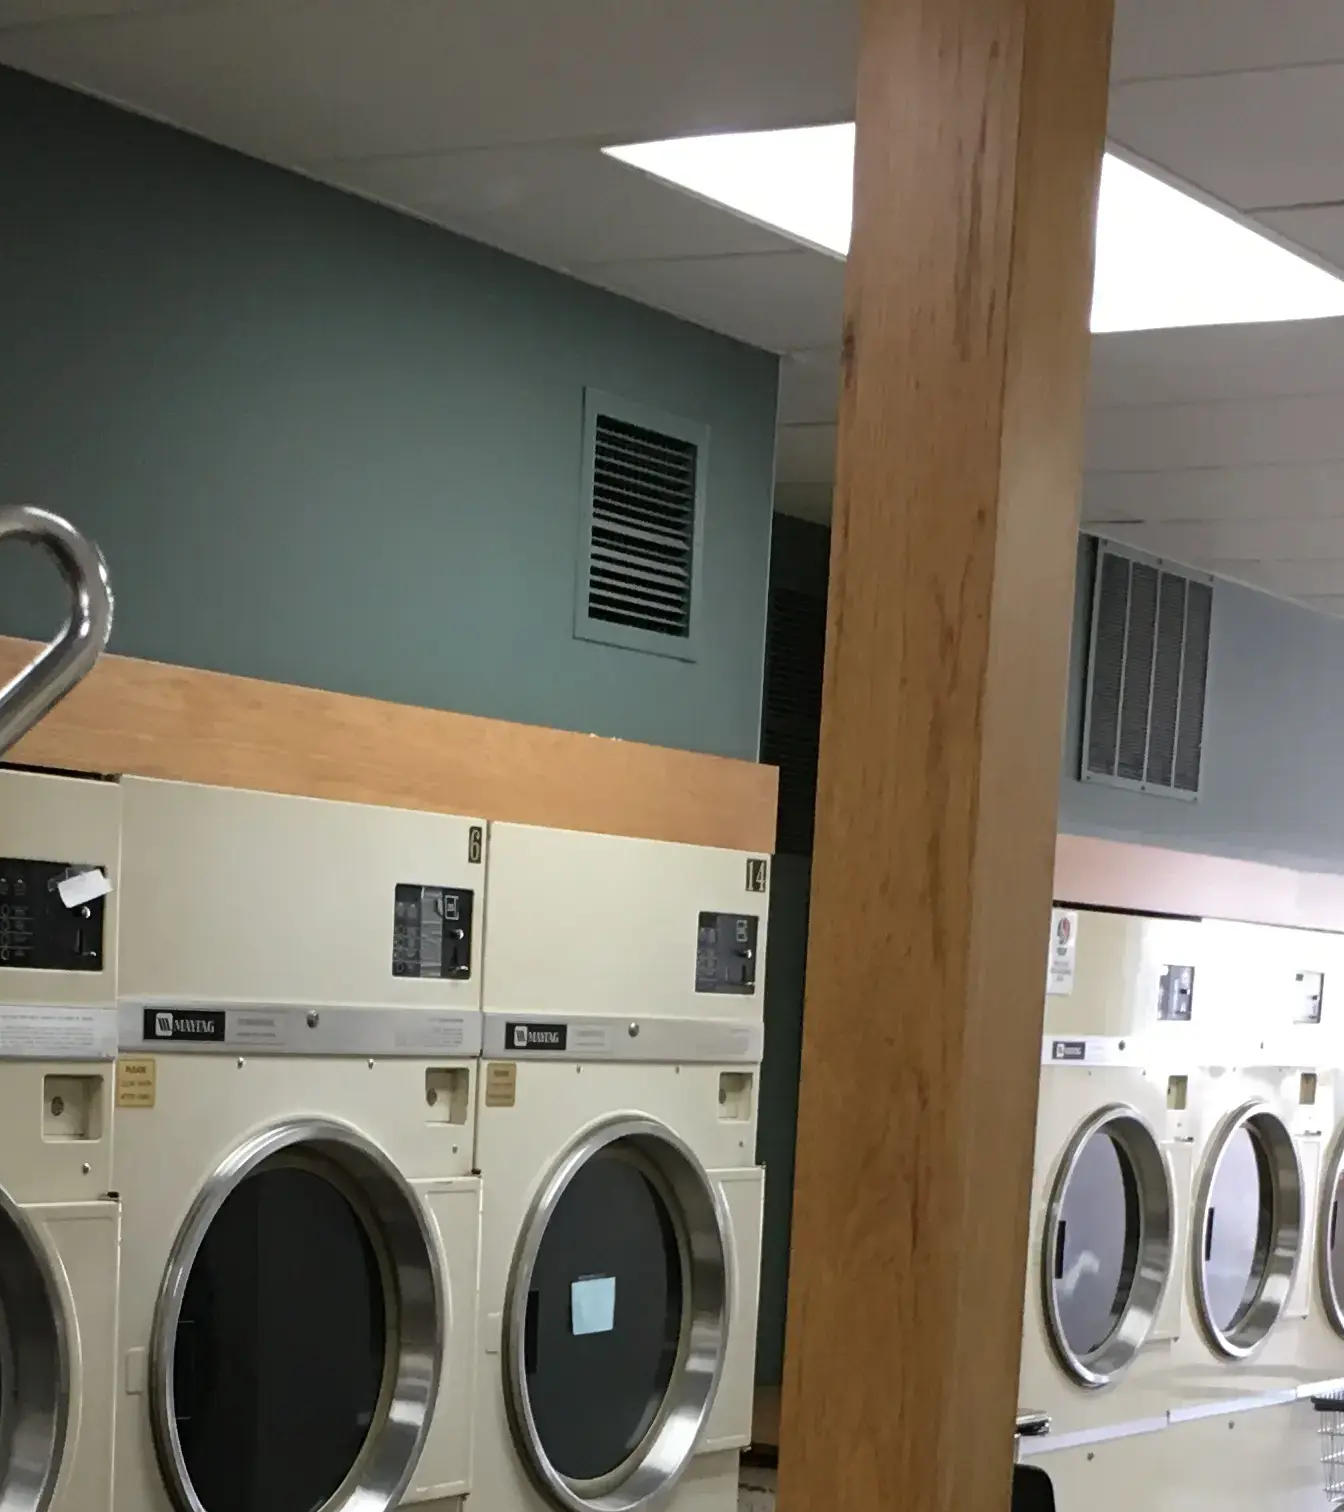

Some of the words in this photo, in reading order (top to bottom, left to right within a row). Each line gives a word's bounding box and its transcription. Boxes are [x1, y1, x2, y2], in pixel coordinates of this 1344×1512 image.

[470, 829, 481, 861] 6
[748, 861, 766, 891] 14
[174, 1019, 215, 1033] MAYTAG
[528, 1031, 559, 1044] MAYTAG
